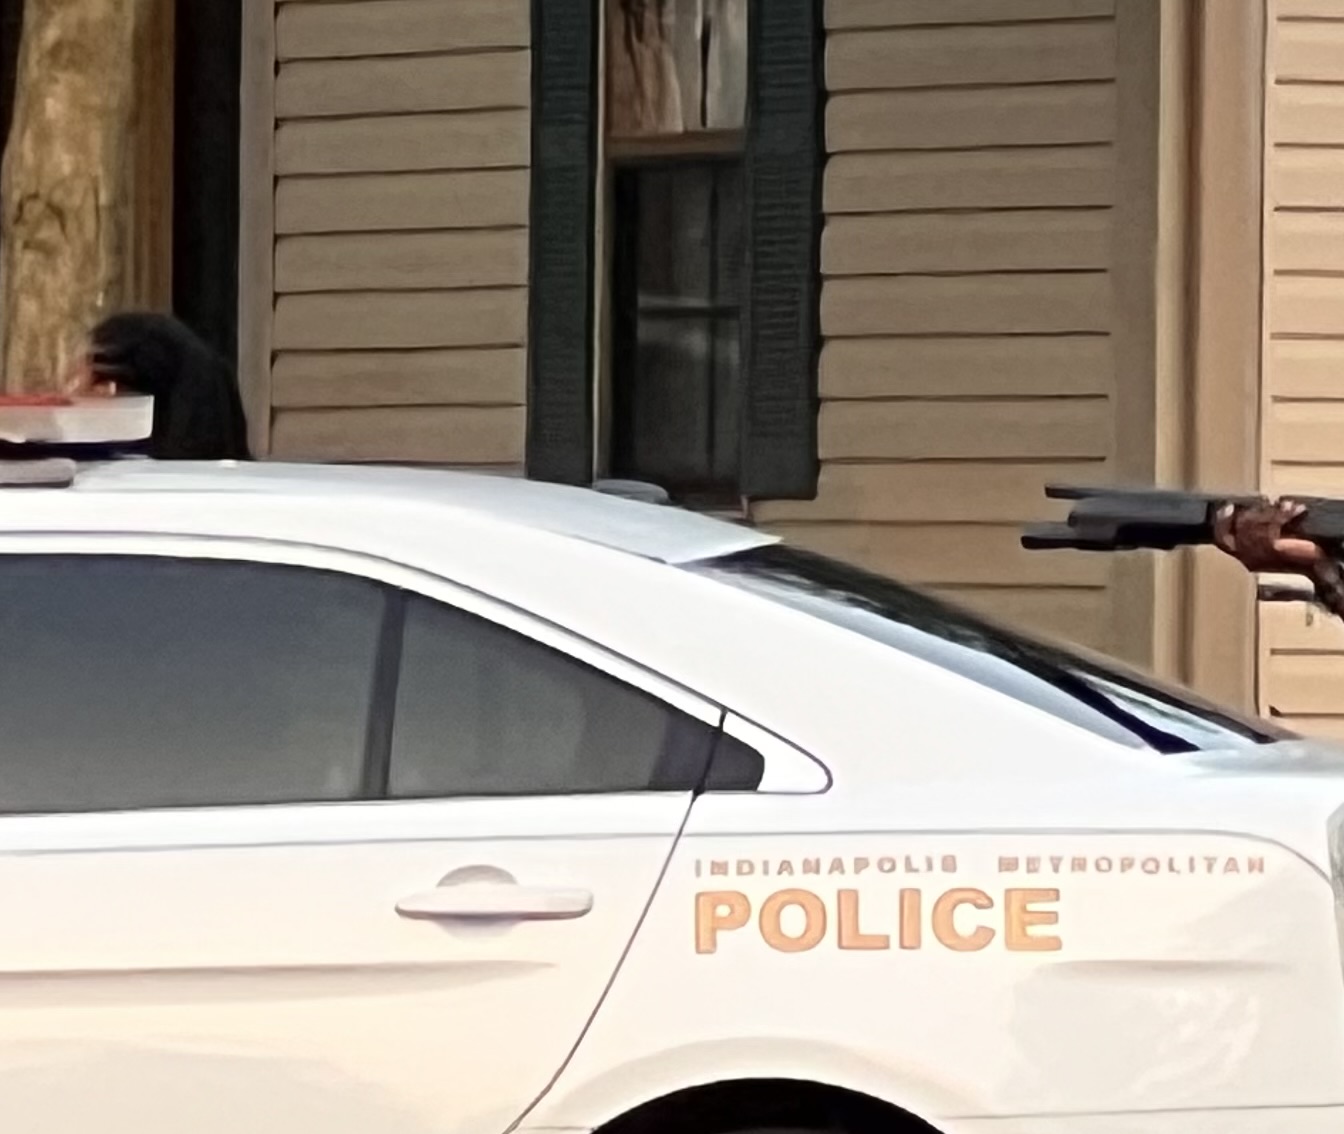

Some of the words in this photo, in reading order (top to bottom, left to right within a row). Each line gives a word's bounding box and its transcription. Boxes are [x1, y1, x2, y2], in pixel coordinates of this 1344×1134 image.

[694, 854, 958, 878] INDIANAPOLIS
[997, 855, 1266, 875] METROPOLITAN
[693, 887, 1063, 955] POLICE
